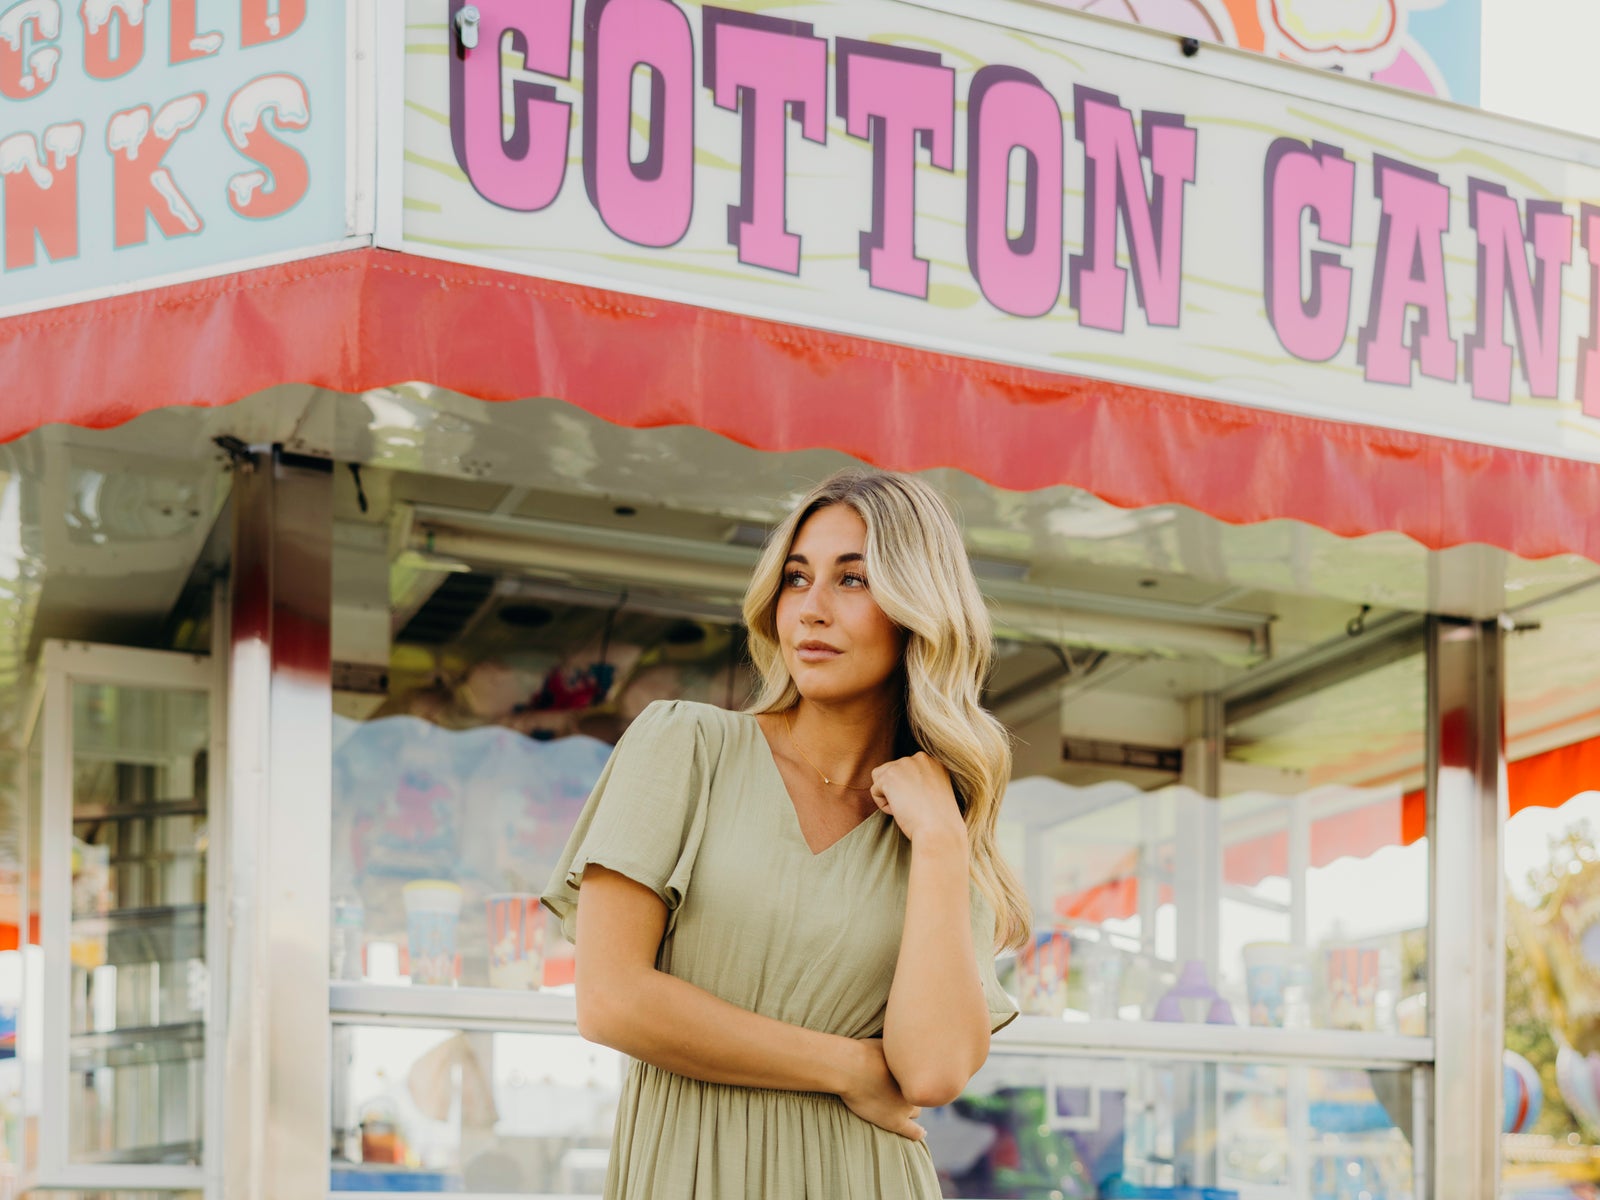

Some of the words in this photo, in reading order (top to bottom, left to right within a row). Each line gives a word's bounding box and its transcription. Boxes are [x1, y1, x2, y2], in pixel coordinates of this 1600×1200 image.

[0, 73, 310, 273] NKS
[450, 0, 1198, 333] COTTON
[1263, 137, 1600, 419] CAN
